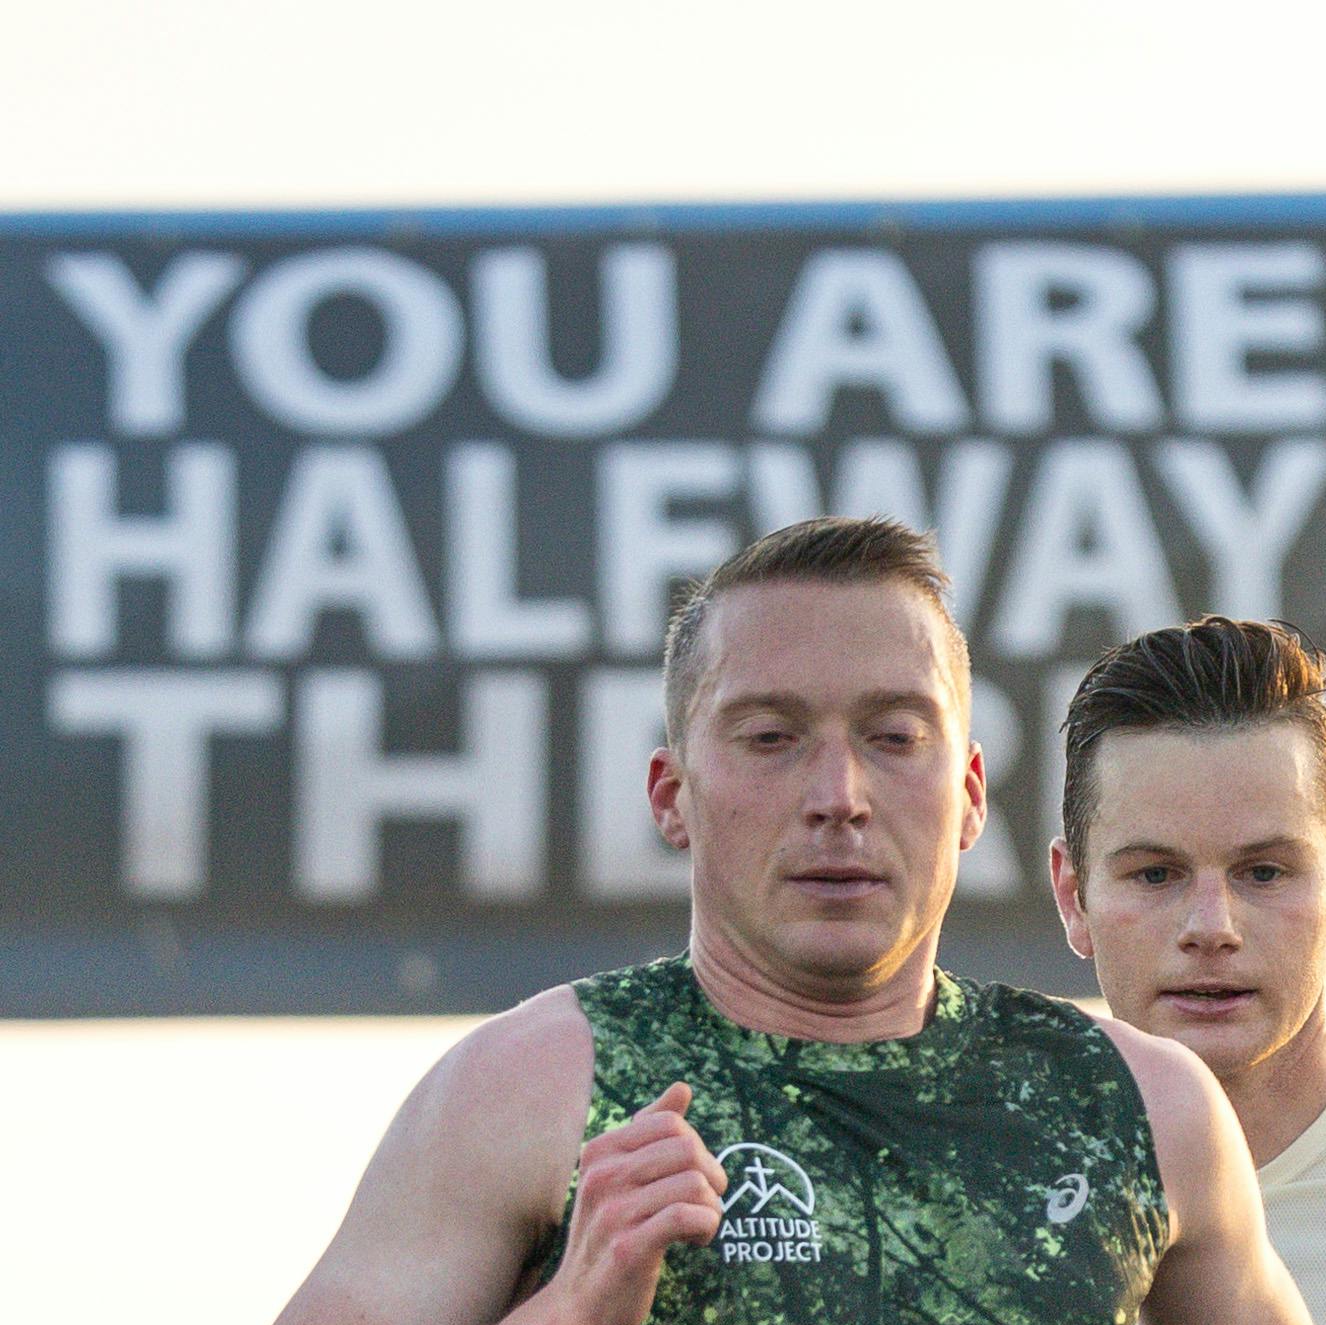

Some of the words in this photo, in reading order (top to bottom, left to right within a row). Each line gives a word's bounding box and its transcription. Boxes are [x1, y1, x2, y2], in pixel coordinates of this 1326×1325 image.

[48, 246, 678, 438] YOU
[720, 1217, 822, 1239] ALTITUDE
[724, 1241, 822, 1263] PROJECT
